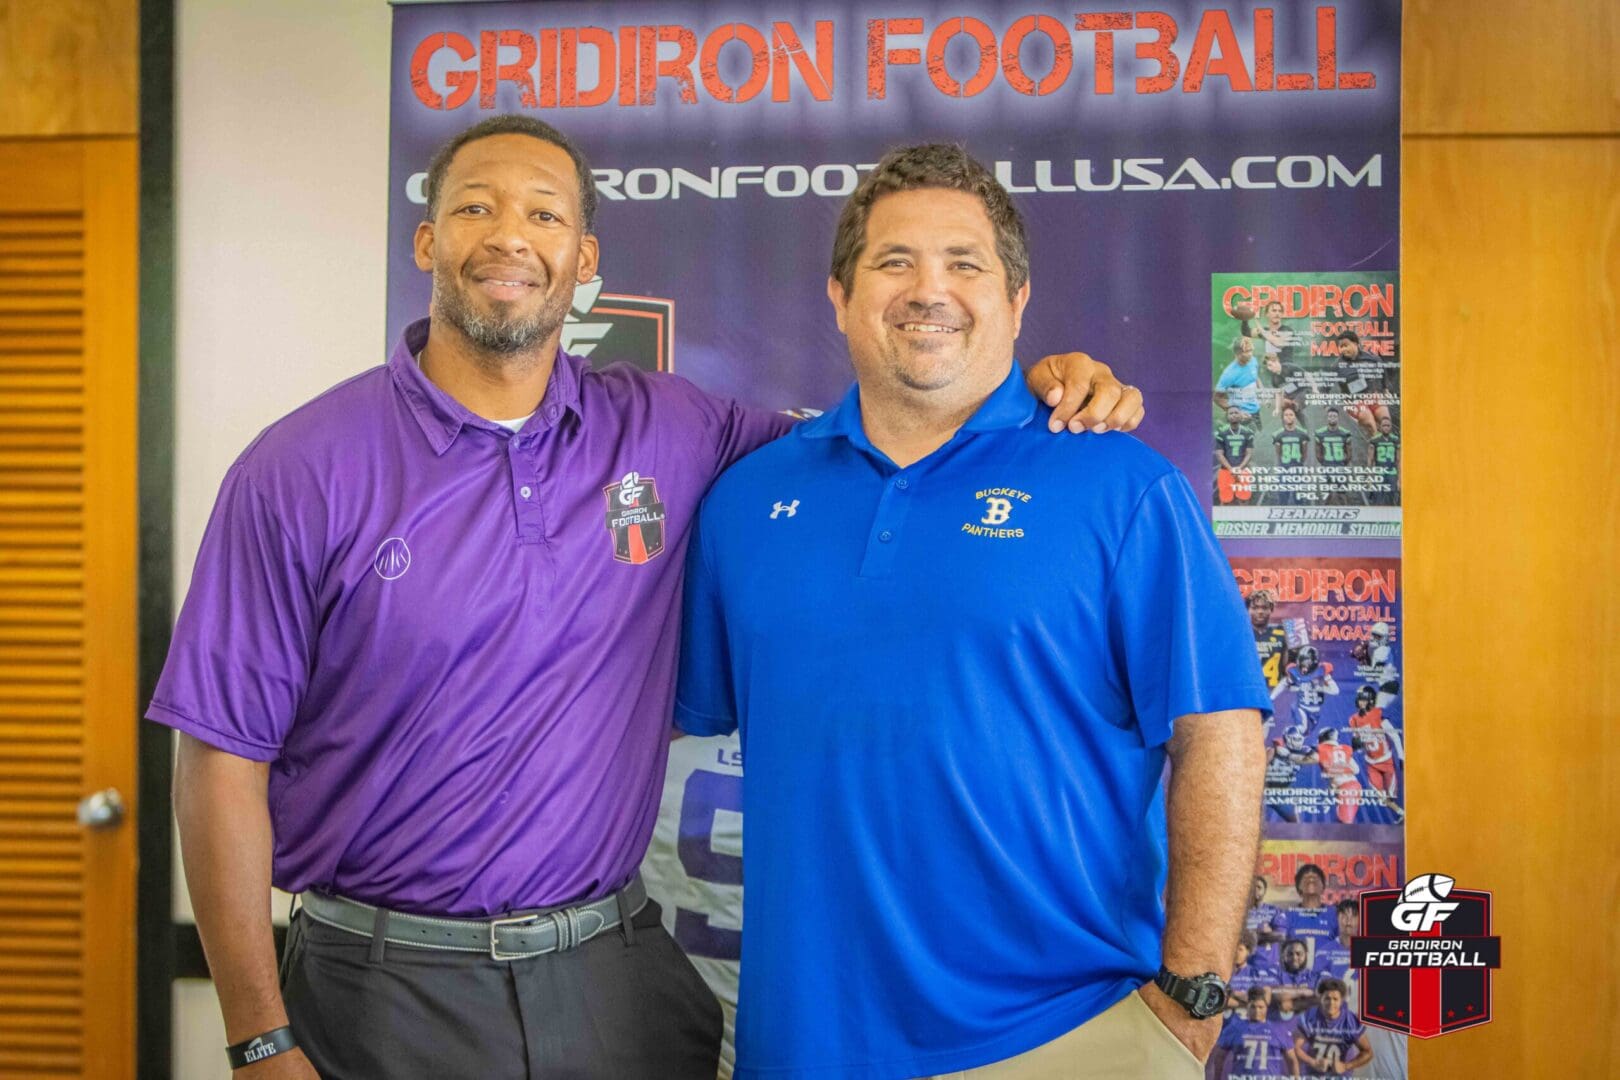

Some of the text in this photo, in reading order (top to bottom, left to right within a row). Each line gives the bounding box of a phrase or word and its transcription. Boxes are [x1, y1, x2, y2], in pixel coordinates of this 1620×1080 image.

[410, 6, 1376, 111] GRIDIRON FOOTBALL
[1222, 283, 1394, 319] GRIDIRON
[1311, 321, 1395, 337] FOOTBALL
[1232, 466, 1392, 474] GARY SMITH GOES BACK
[1239, 475, 1384, 483] TO HIS ROOTS TO LEAD
[619, 486, 645, 505] GF
[975, 488, 1032, 503] BUCKEYE
[1231, 484, 1391, 492] THE BOSSIER BEARKATS
[1296, 492, 1330, 500] PG. 7
[981, 497, 1013, 525] B
[611, 511, 661, 528] FOOTBALL
[961, 523, 1025, 538] PANTHERS
[1216, 522, 1400, 537] BOSSIER MEMORIAL STADIUM
[1232, 568, 1396, 603] GRIDIRON
[1311, 605, 1396, 623] FOOTBALL
[1263, 788, 1329, 796] GRIDIRON
[1264, 797, 1344, 805] AMERICAN
[244, 1042, 276, 1063] ELITE
